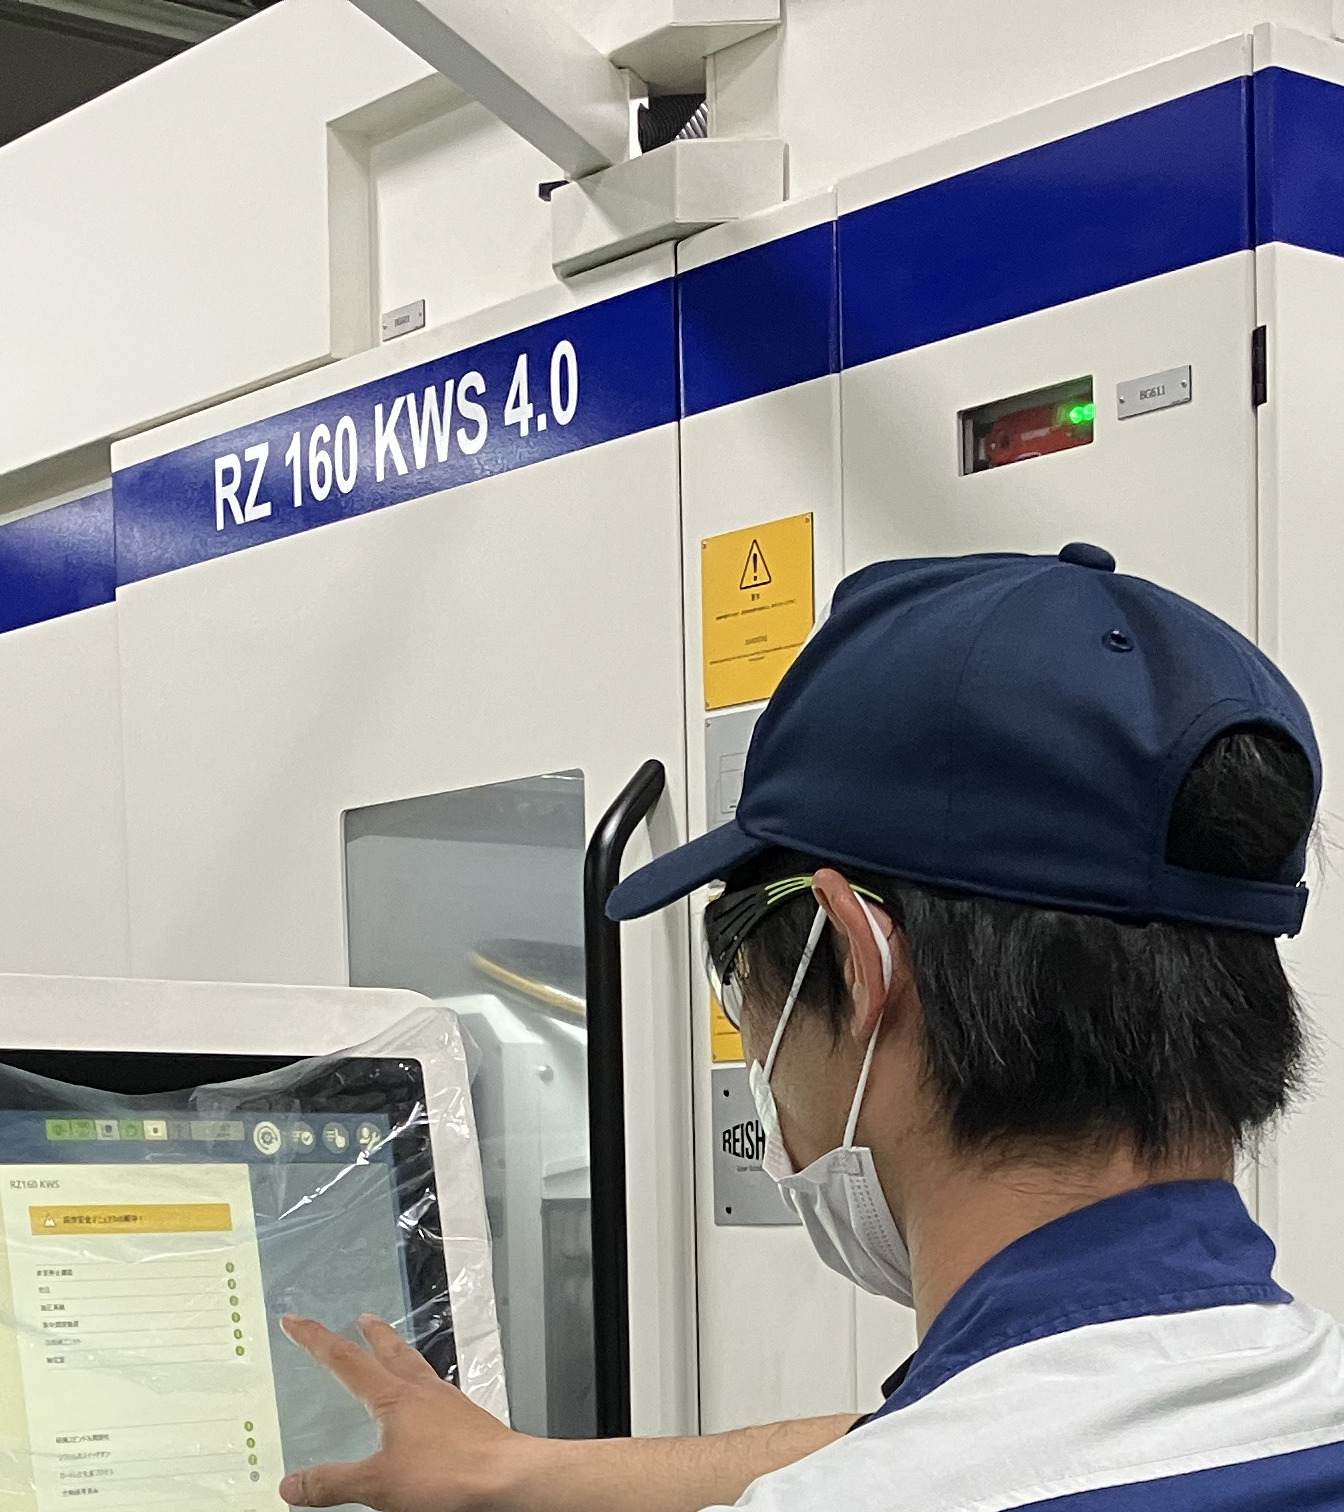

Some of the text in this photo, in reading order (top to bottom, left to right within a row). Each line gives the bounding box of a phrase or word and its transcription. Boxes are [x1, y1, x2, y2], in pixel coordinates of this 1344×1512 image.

[214, 339, 579, 531] RZ 160 KWS 4.0
[1139, 384, 1166, 401] BG611
